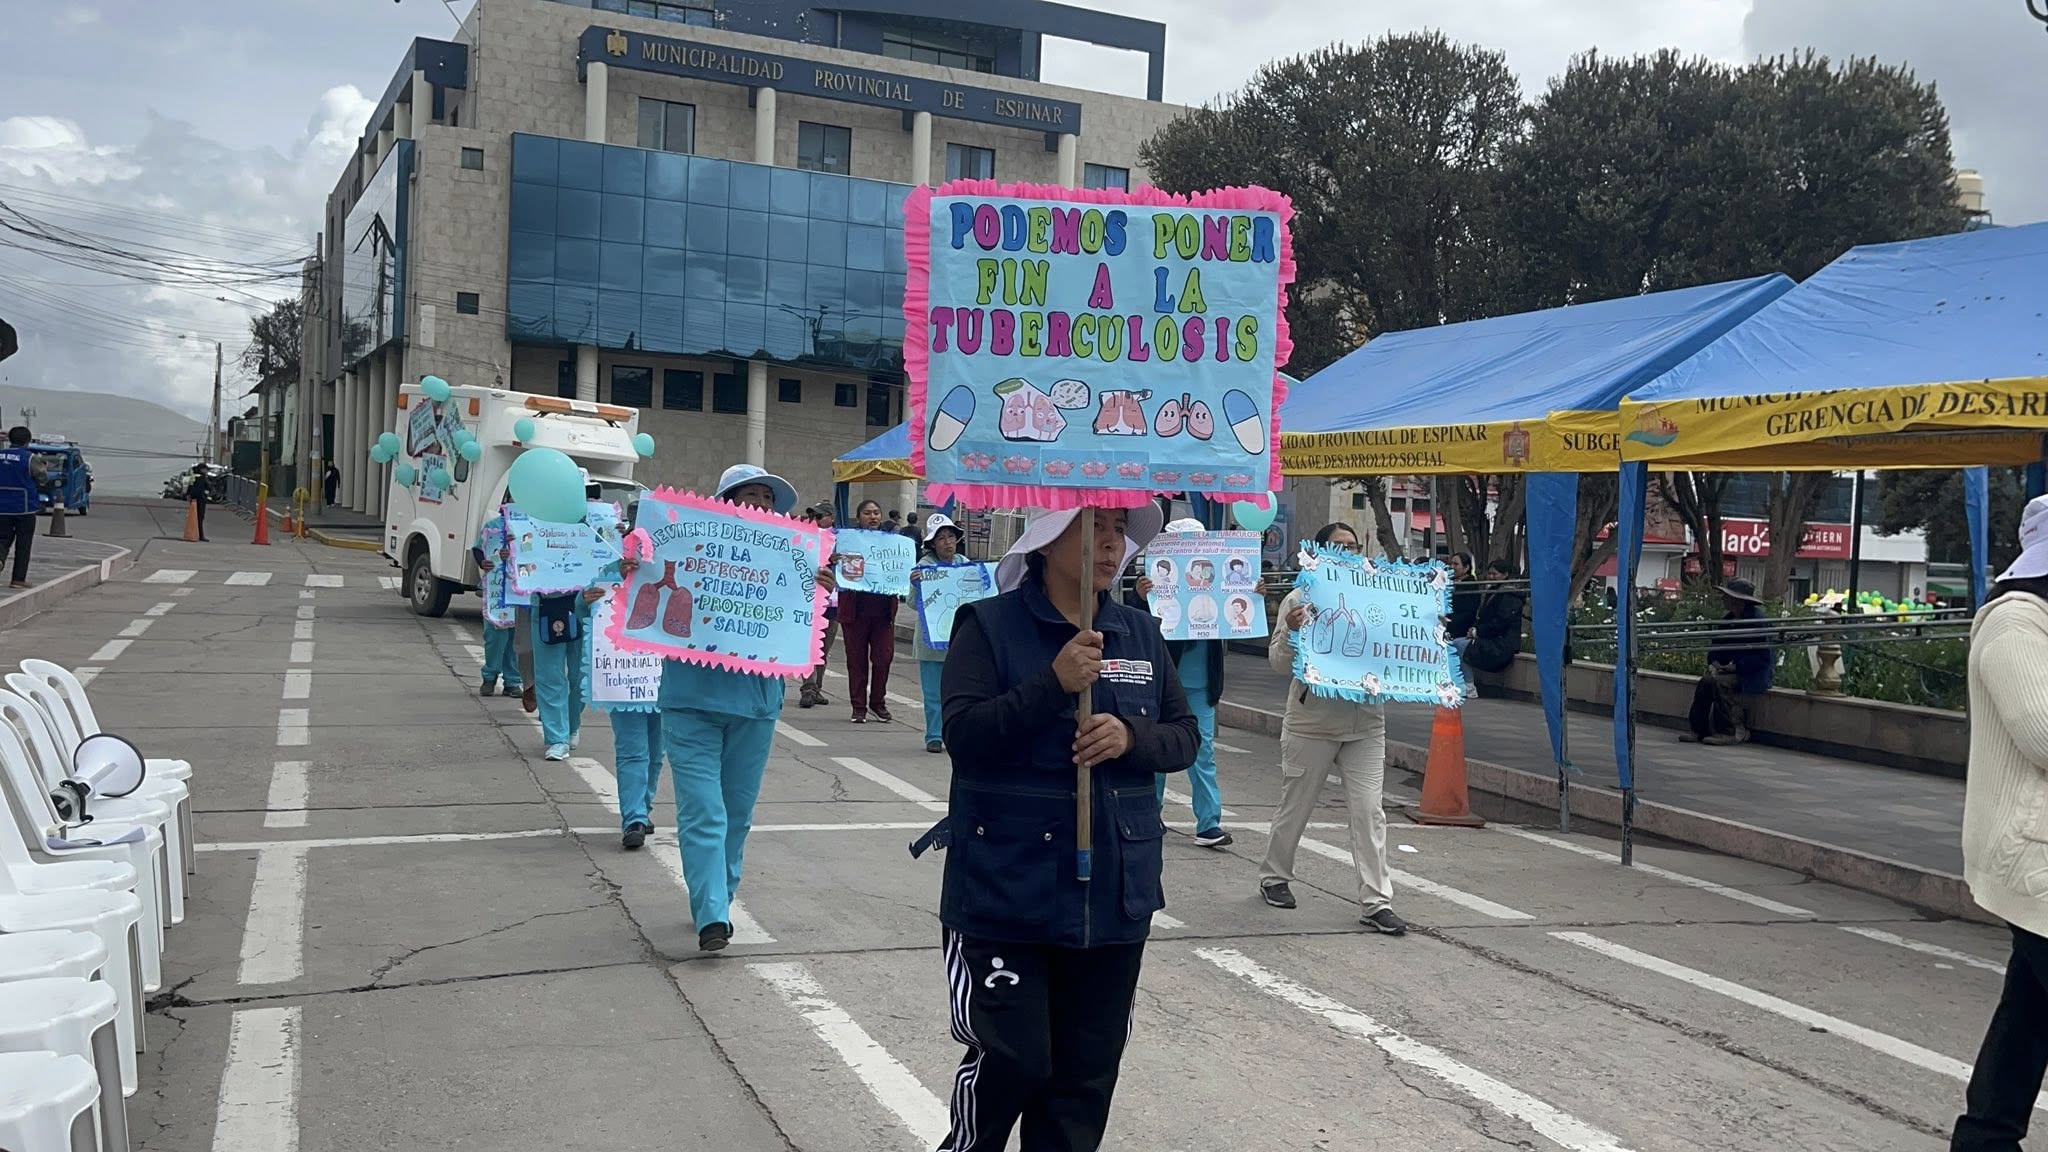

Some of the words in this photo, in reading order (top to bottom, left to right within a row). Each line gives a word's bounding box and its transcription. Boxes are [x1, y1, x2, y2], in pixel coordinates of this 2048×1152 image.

[642, 41, 784, 80] MUNICIPALIDAD
[815, 69, 912, 102] PROVINCIAL
[943, 90, 965, 109] DE
[995, 98, 1063, 124] ESPINAR
[949, 202, 1128, 256] PODEMOS
[1153, 213, 1275, 263] PONER
[976, 258, 1050, 306] FIN
[1088, 262, 1114, 309] A
[1154, 266, 1206, 313] LA
[930, 306, 1258, 362] TUBERCULOSIS
[1767, 398, 1894, 436] GERENCIA
[1318, 429, 1398, 448] PROVINCIAL
[1400, 428, 1418, 445] DE
[1423, 424, 1488, 443] ESPINAR
[1308, 454, 1321, 469] DE
[1323, 452, 1398, 469] DESARROLLO
[1399, 451, 1446, 468] SOCIAL
[720, 523, 790, 552] DETECTA
[1706, 529, 1761, 553] laro
[705, 542, 724, 559] SI
[731, 546, 751, 562] LA
[870, 543, 910, 560] Familia
[684, 557, 770, 585] DETECTAS
[776, 572, 787, 587] A
[1326, 567, 1341, 582] LA
[1349, 569, 1428, 595] TUBERCULOSIS
[702, 577, 768, 601] TIEMPO
[698, 594, 784, 622] PROTEGES
[793, 609, 813, 627] TU
[1399, 603, 1420, 620] SE
[714, 616, 769, 638] SALUD
[1392, 622, 1430, 641] CURA
[595, 653, 612, 669] DÍA
[614, 656, 653, 669] MUNDIAL
[1373, 642, 1441, 665] DETECTALA
[602, 672, 649, 689] Trabajemos
[1383, 664, 1392, 681] A
[1397, 665, 1442, 685] TIEMPO
[630, 685, 646, 700] FIN
[647, 689, 654, 697] a
